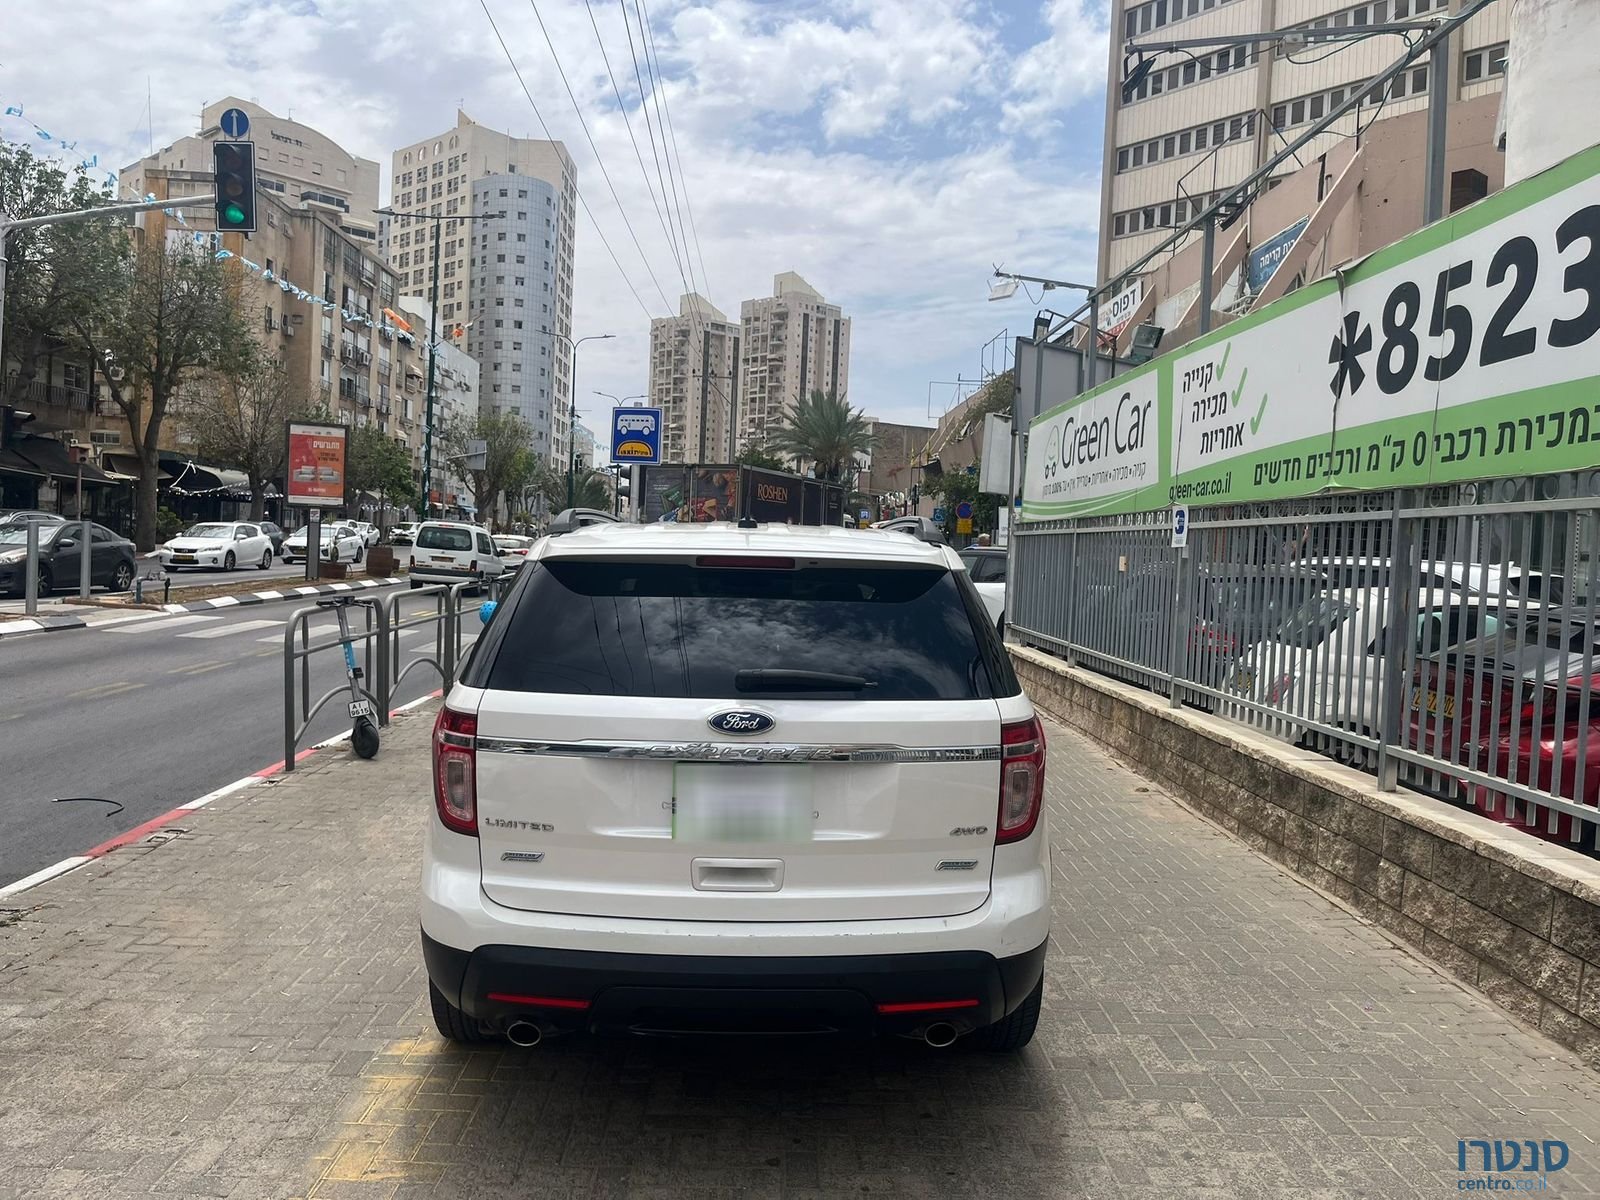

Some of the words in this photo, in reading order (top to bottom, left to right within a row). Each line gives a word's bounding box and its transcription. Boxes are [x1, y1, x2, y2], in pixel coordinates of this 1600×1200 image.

[1260, 246, 1280, 268] קדימה
[1113, 289, 1137, 317] דפוס
[1183, 362, 1213, 393] קנייה
[1192, 391, 1228, 423] מכירה
[1062, 417, 1109, 469] Green
[1114, 392, 1151, 454] Car
[1200, 422, 1245, 455] אחריות
[1433, 426, 1487, 463] רכבי
[1305, 446, 1362, 480] ורכבים
[1413, 430, 1427, 467] 0
[1253, 456, 1301, 486] חדשים
[757, 484, 788, 501] ROSHEN
[722, 712, 759, 729] Ford
[649, 744, 834, 760] EXPLORER
[485, 817, 554, 832] LIMITED
[950, 826, 988, 836] 4WD
